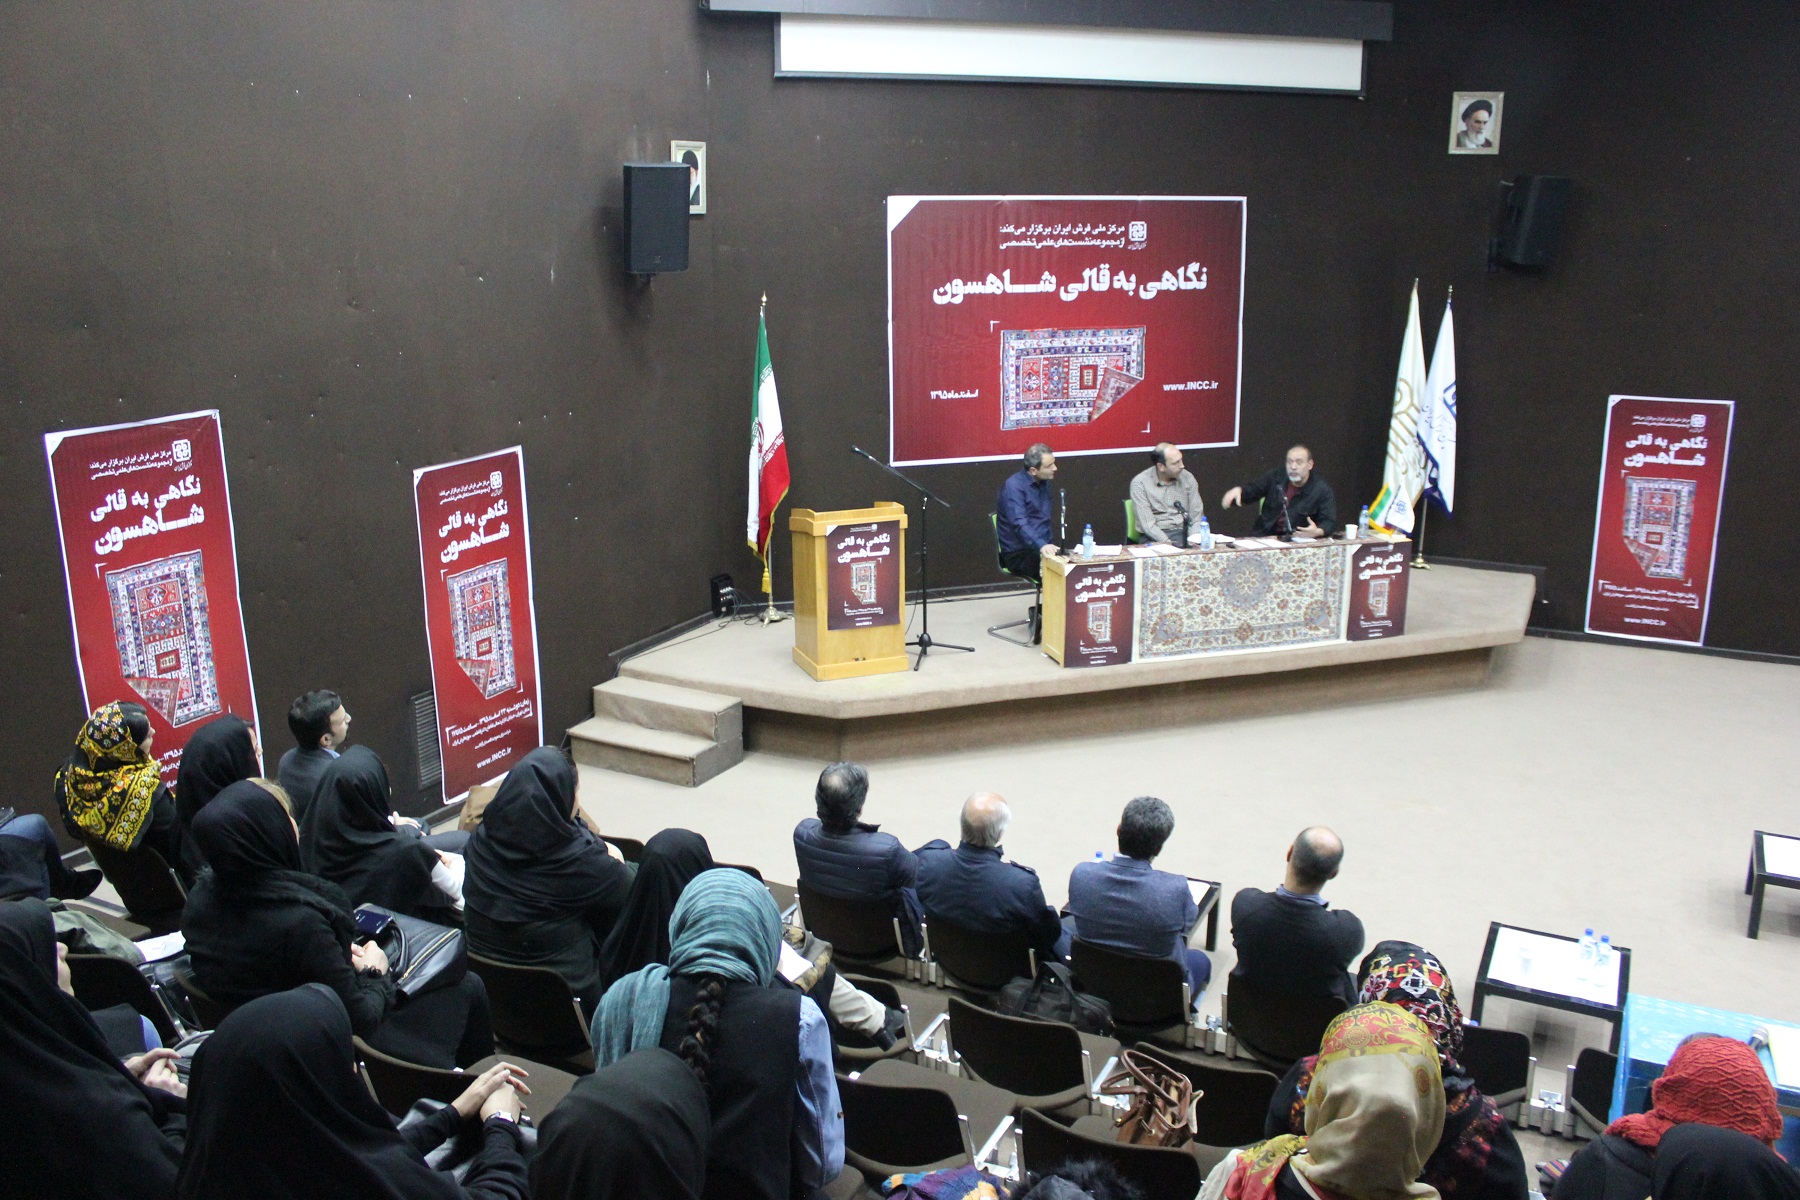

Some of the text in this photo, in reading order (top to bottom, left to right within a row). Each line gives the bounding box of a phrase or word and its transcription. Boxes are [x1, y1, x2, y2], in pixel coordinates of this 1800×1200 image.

[1026, 223, 1051, 235] برگزار
[1052, 223, 1071, 235] ایران
[1072, 223, 1091, 234] فرش
[1092, 224, 1106, 235] ملی
[1107, 224, 1125, 235] مرکز
[932, 261, 1208, 306] نگاهی به قالی شاهسون
[1163, 380, 1218, 391] www.INCC.ir
[1625, 433, 1708, 451] نگاهی به قالی
[90, 475, 201, 522] نگاهی به قالی
[438, 498, 508, 538] نگاهی به قالی
[95, 503, 205, 555] شاهسون
[440, 521, 510, 563] شاهسون
[866, 533, 890, 548] نگاهی
[476, 747, 512, 769] www.INCC.ir
